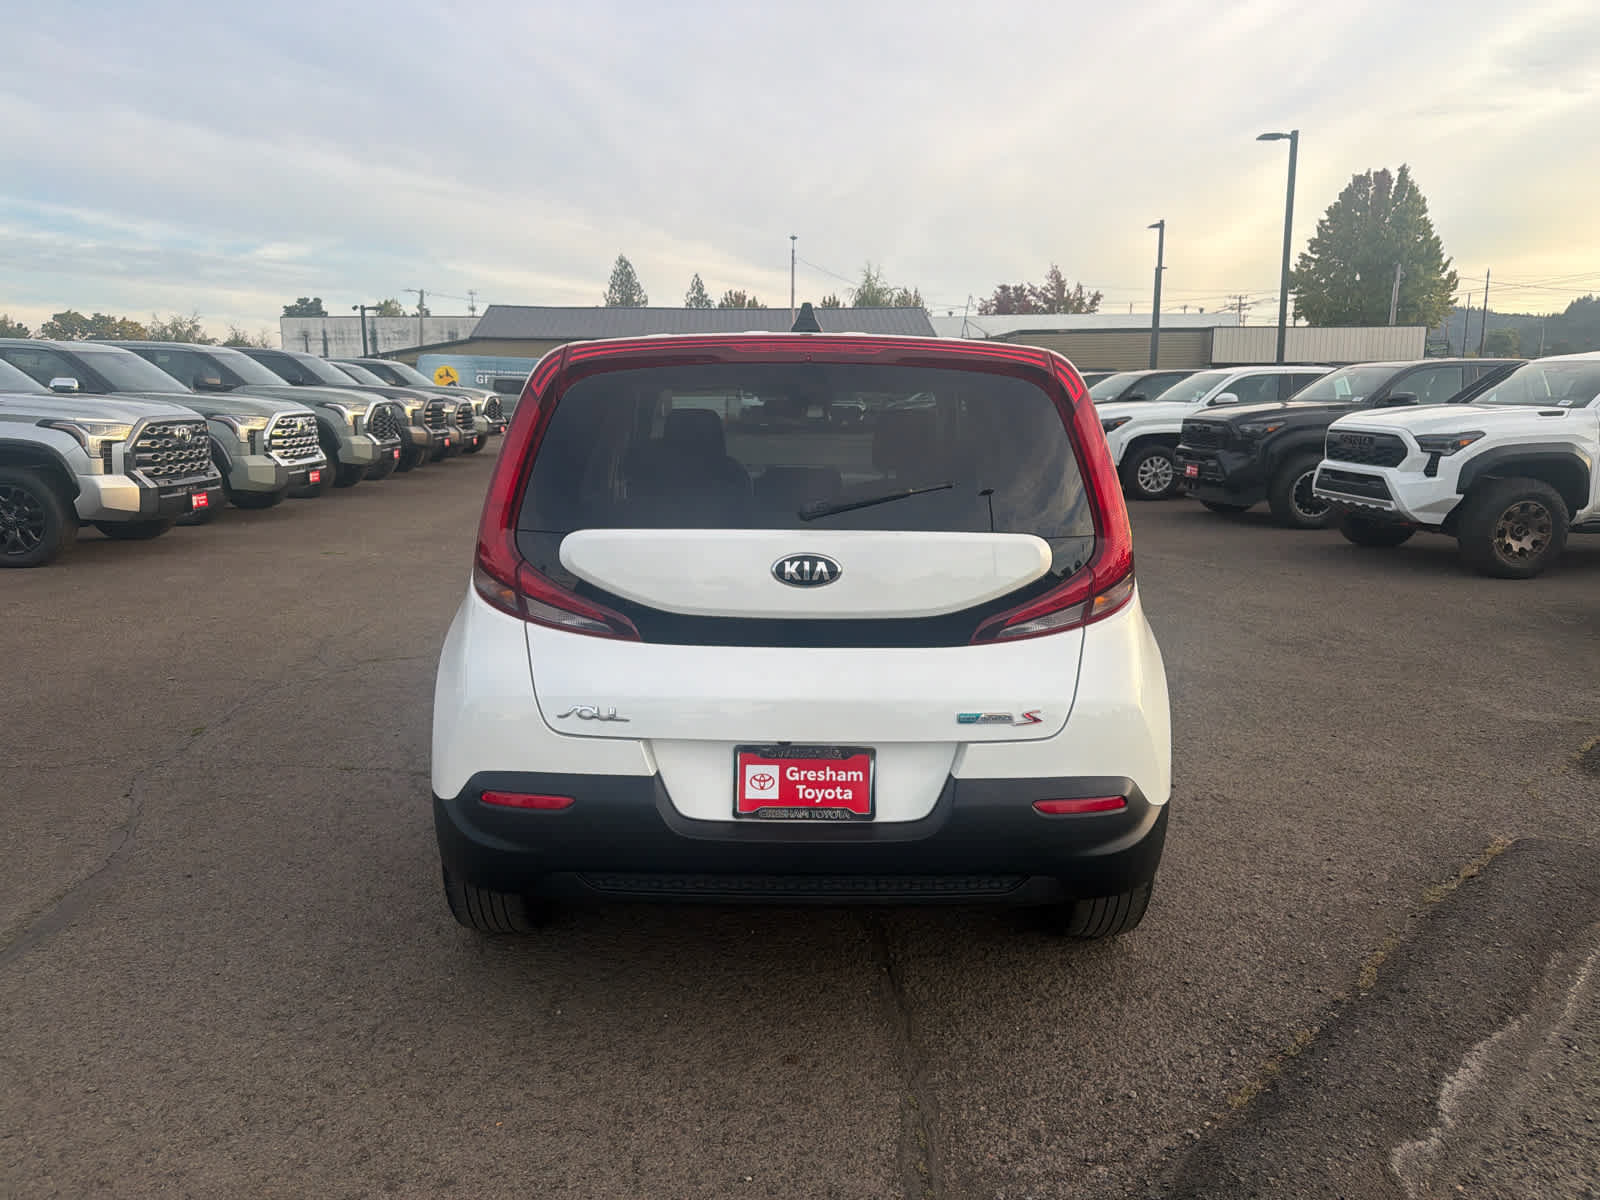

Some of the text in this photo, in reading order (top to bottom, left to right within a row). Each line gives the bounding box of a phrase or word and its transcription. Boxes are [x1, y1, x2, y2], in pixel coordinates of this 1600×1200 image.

[784, 560, 830, 580] KIA
[556, 704, 631, 721] SOUL
[786, 766, 863, 782] Gresham
[796, 785, 853, 803] Toyota
[810, 808, 850, 819] TOYOTA
